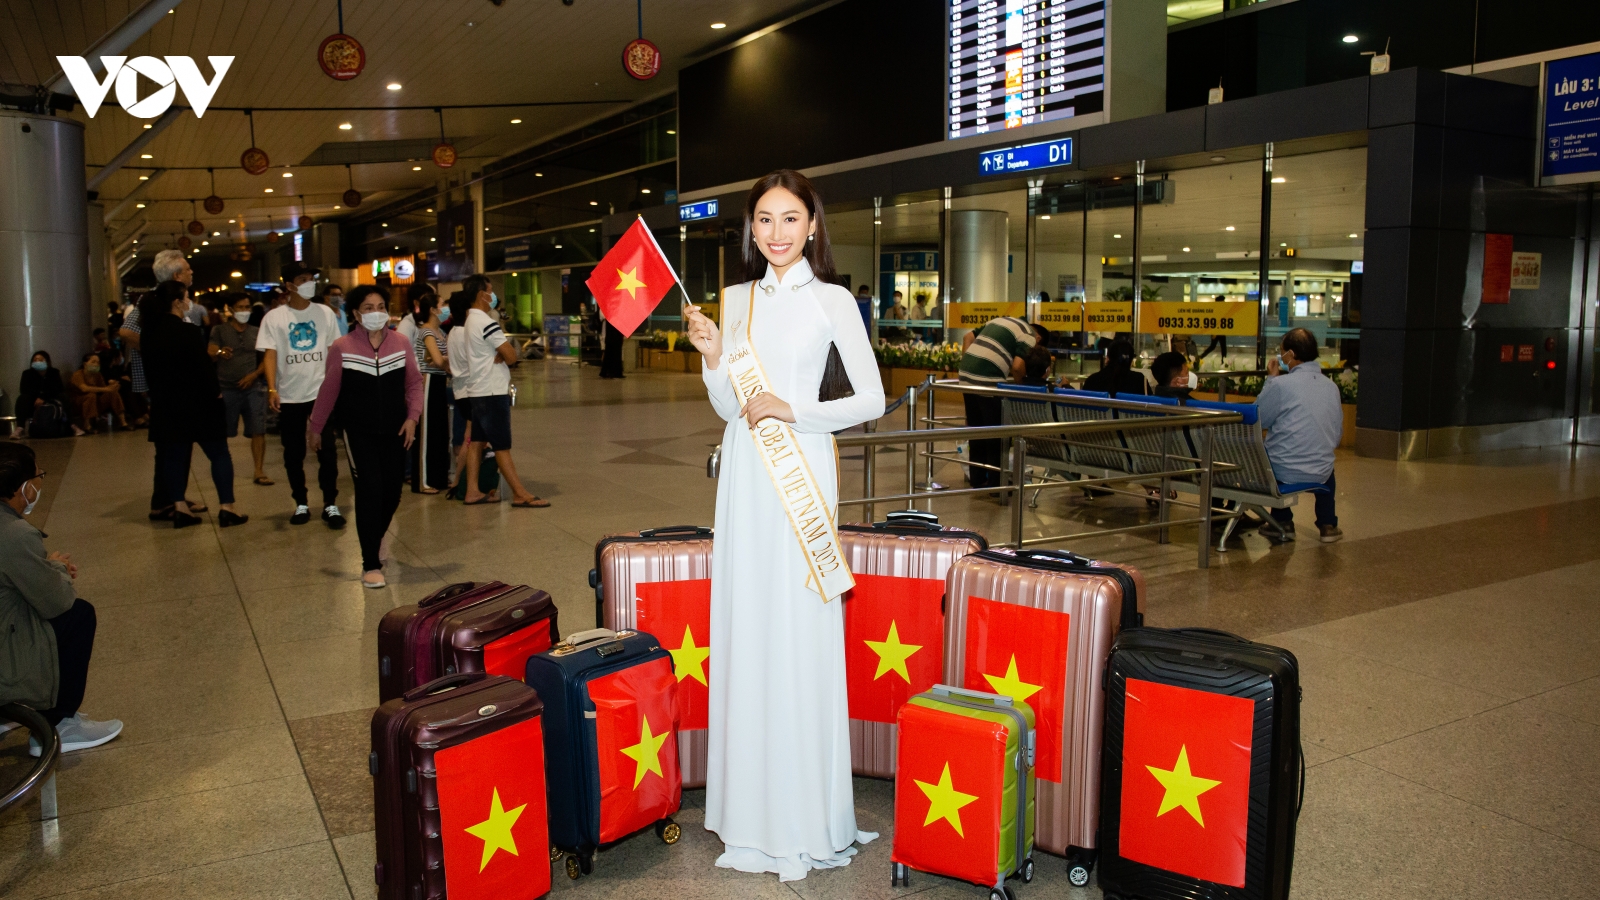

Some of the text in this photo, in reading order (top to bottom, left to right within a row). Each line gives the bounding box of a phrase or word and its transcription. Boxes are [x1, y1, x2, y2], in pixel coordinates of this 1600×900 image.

[1581, 78, 1594, 92] 3:
[1564, 97, 1599, 112] Level
[1049, 144, 1067, 162] D1
[1007, 160, 1029, 169] Departure
[708, 203, 716, 214] D1
[1158, 317, 1234, 329] 0933.33.99.88
[286, 352, 323, 365] GUCCI
[780, 466, 828, 545] VIETNAM
[811, 542, 839, 578] 2022
